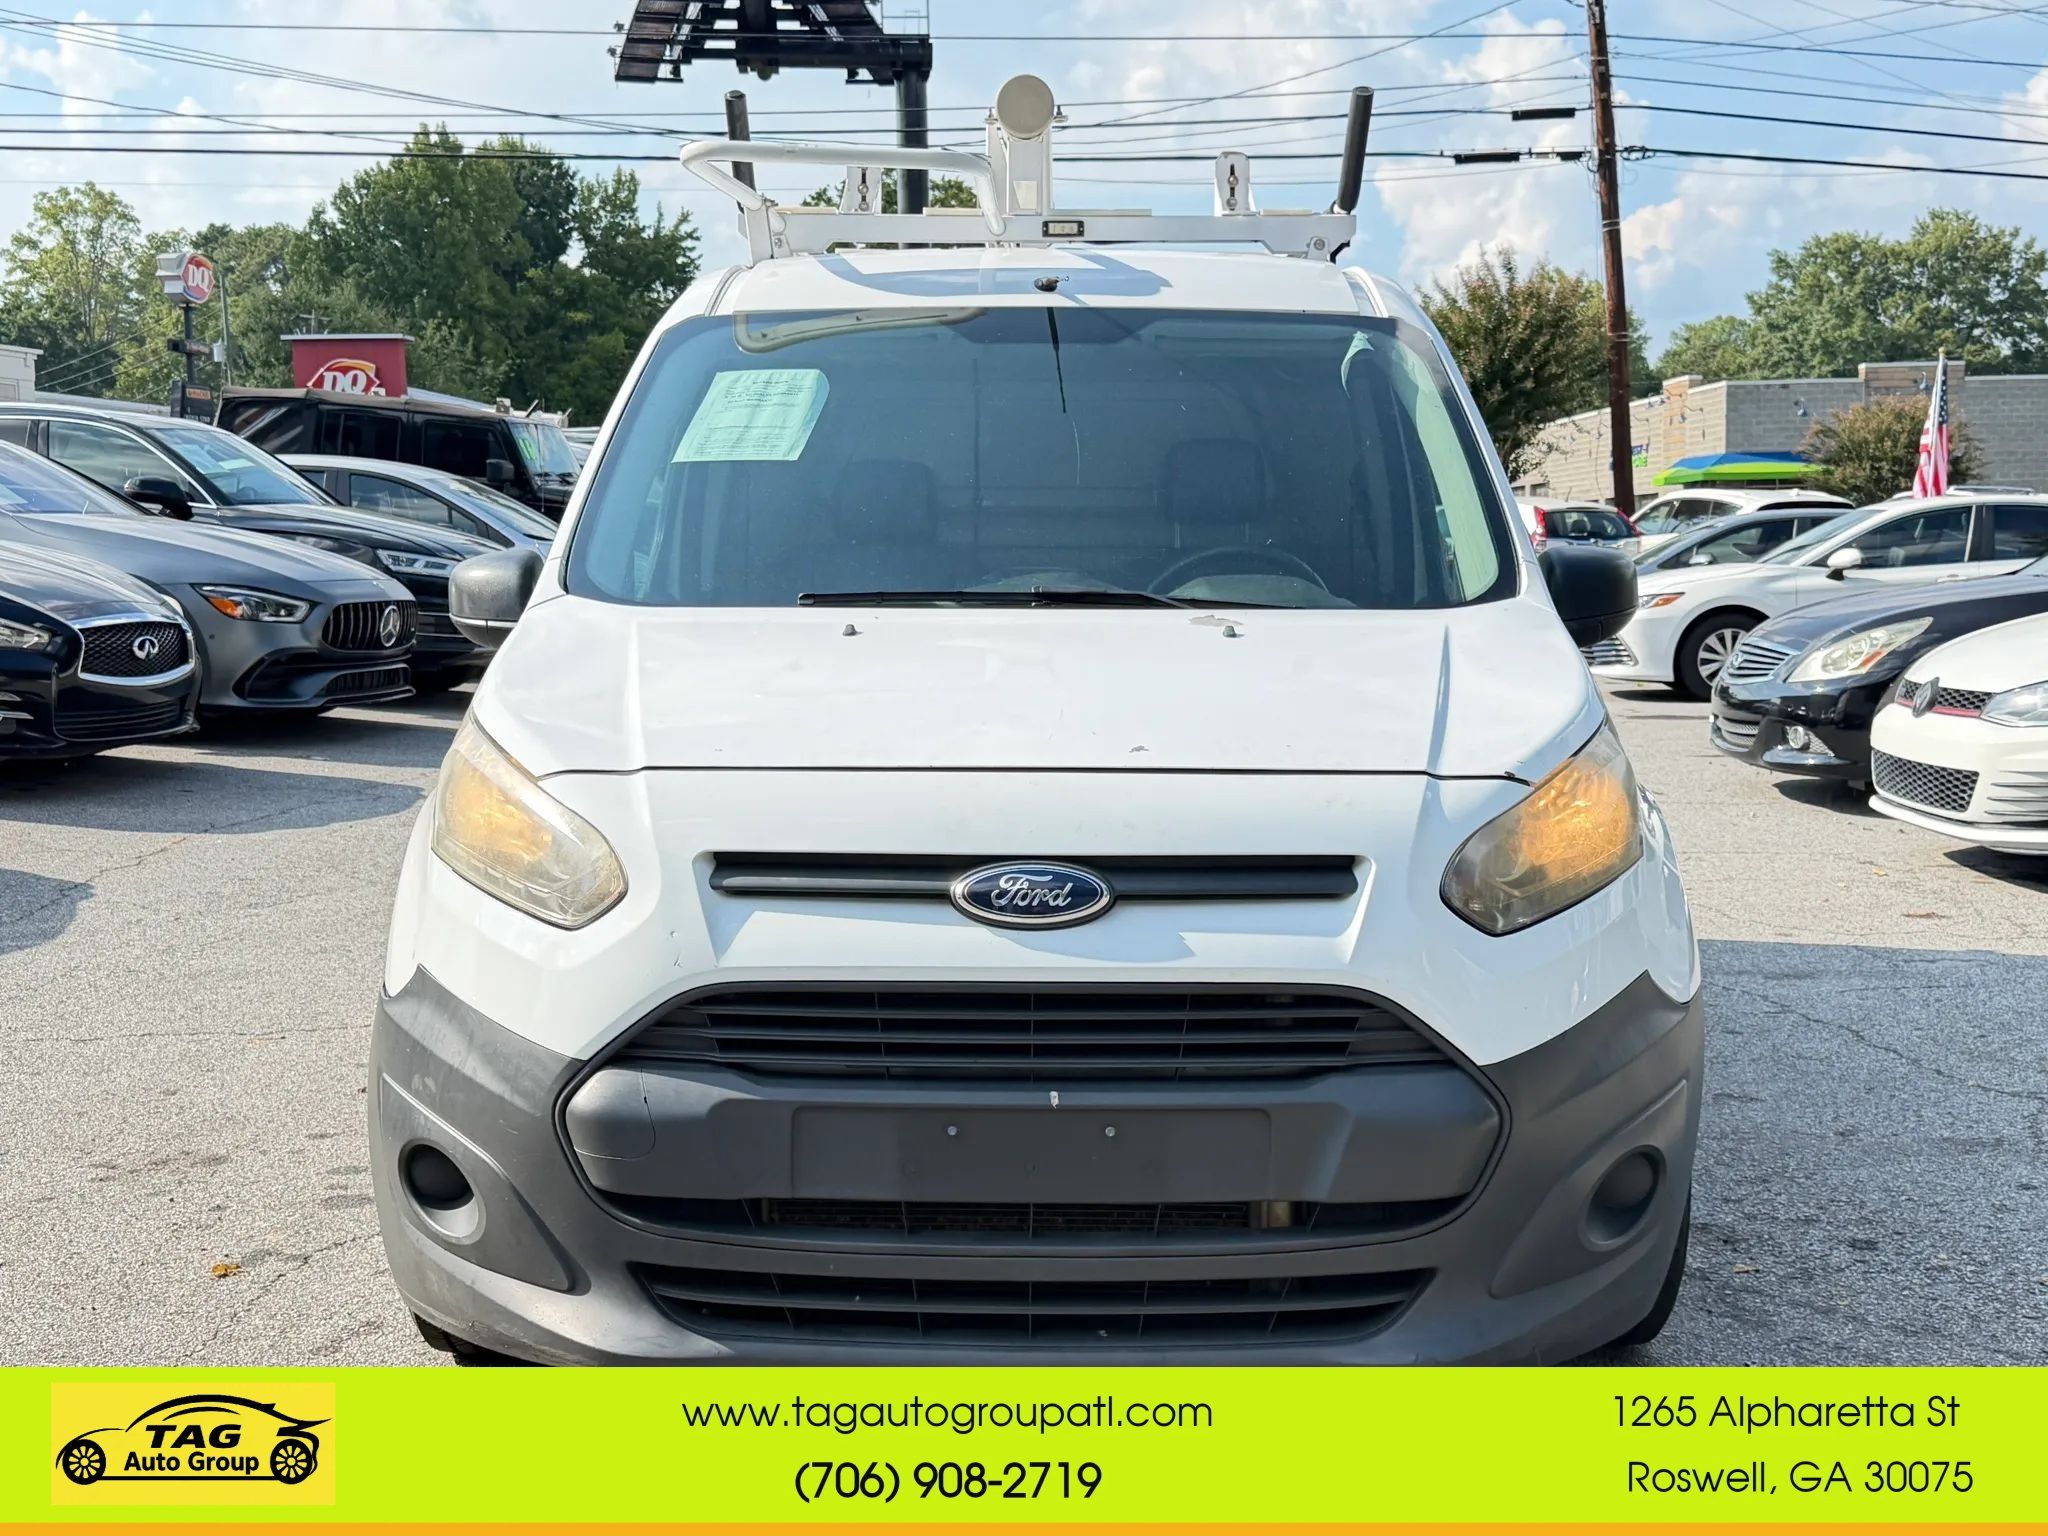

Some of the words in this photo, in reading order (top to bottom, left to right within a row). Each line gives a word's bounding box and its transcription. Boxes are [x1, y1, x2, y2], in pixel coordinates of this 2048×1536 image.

[187, 263, 210, 292] DQ
[323, 369, 368, 396] DQ
[991, 873, 1074, 907] Ford
